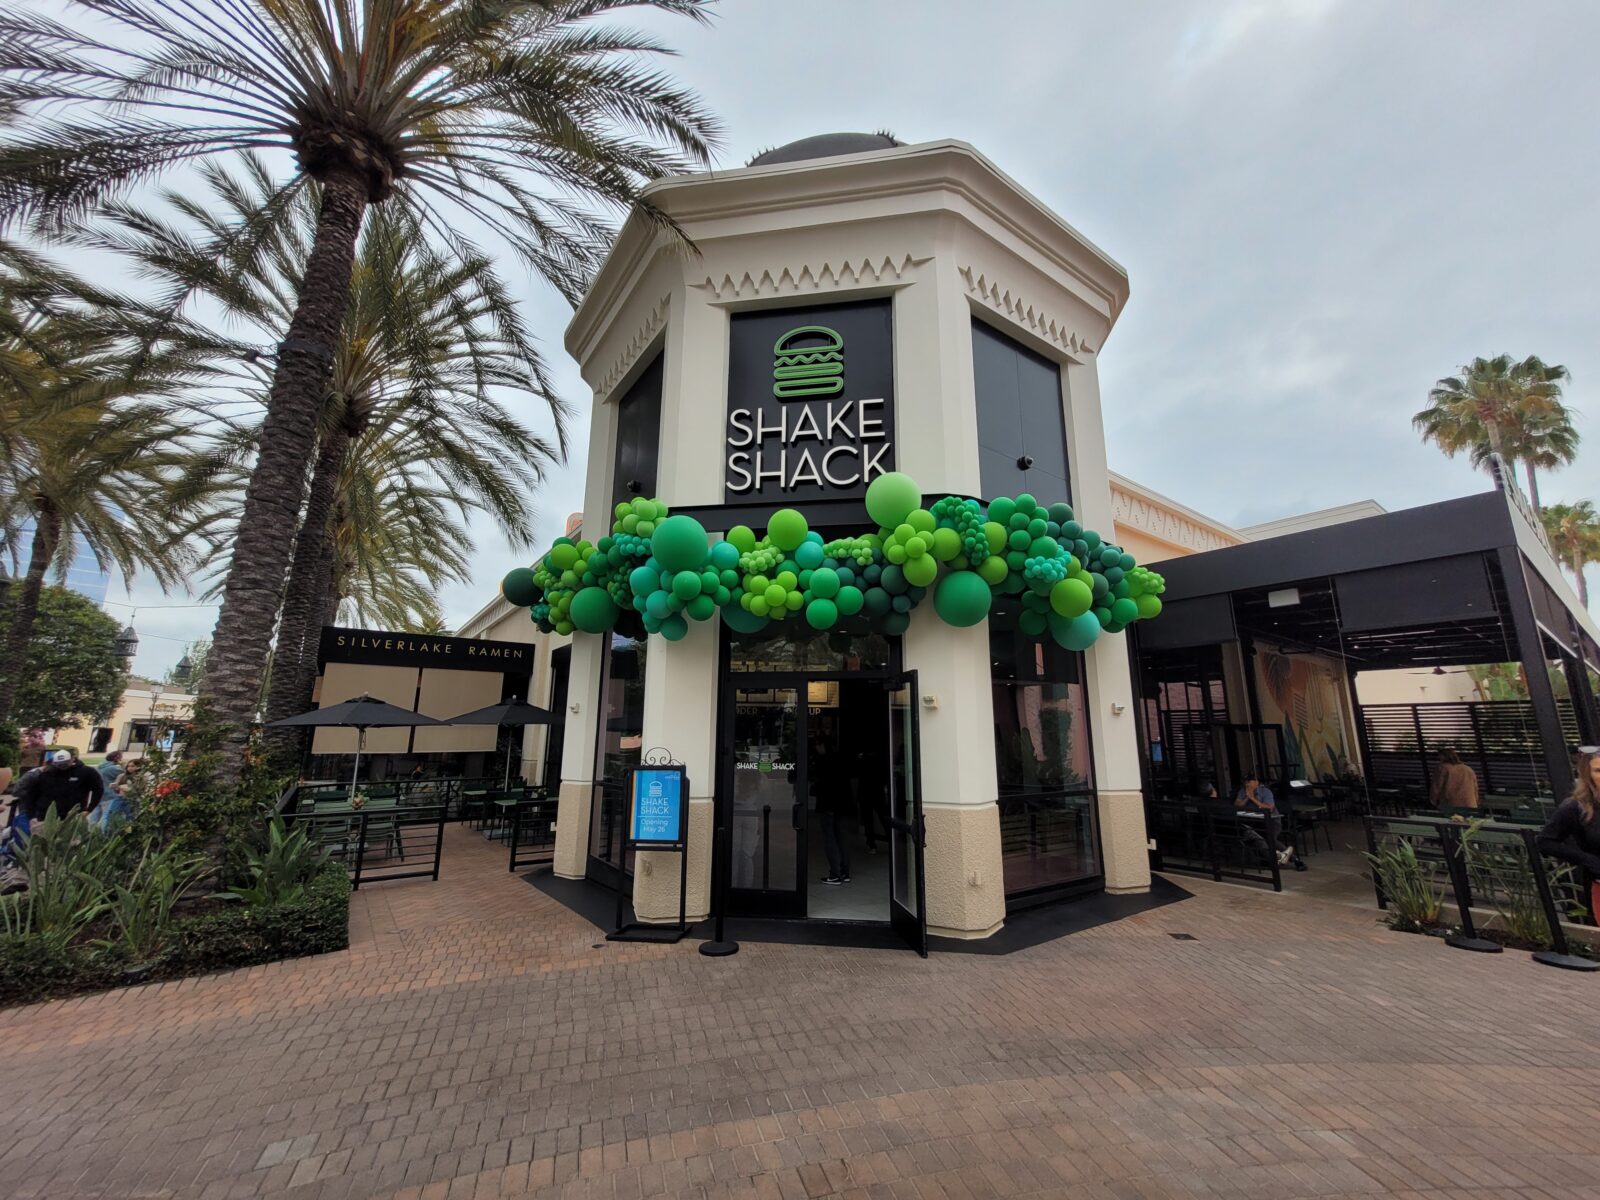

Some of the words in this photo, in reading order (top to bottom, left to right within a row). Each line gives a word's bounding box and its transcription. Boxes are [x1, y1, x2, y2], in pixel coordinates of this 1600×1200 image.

[728, 398, 885, 446] SHAKE
[726, 443, 891, 490] SHACK
[337, 635, 452, 654] SILVERLAKE
[468, 646, 523, 658] RAMEN
[736, 762, 758, 770] SHAKE
[641, 798, 669, 806] SHAKE
[640, 806, 670, 815] SHACK
